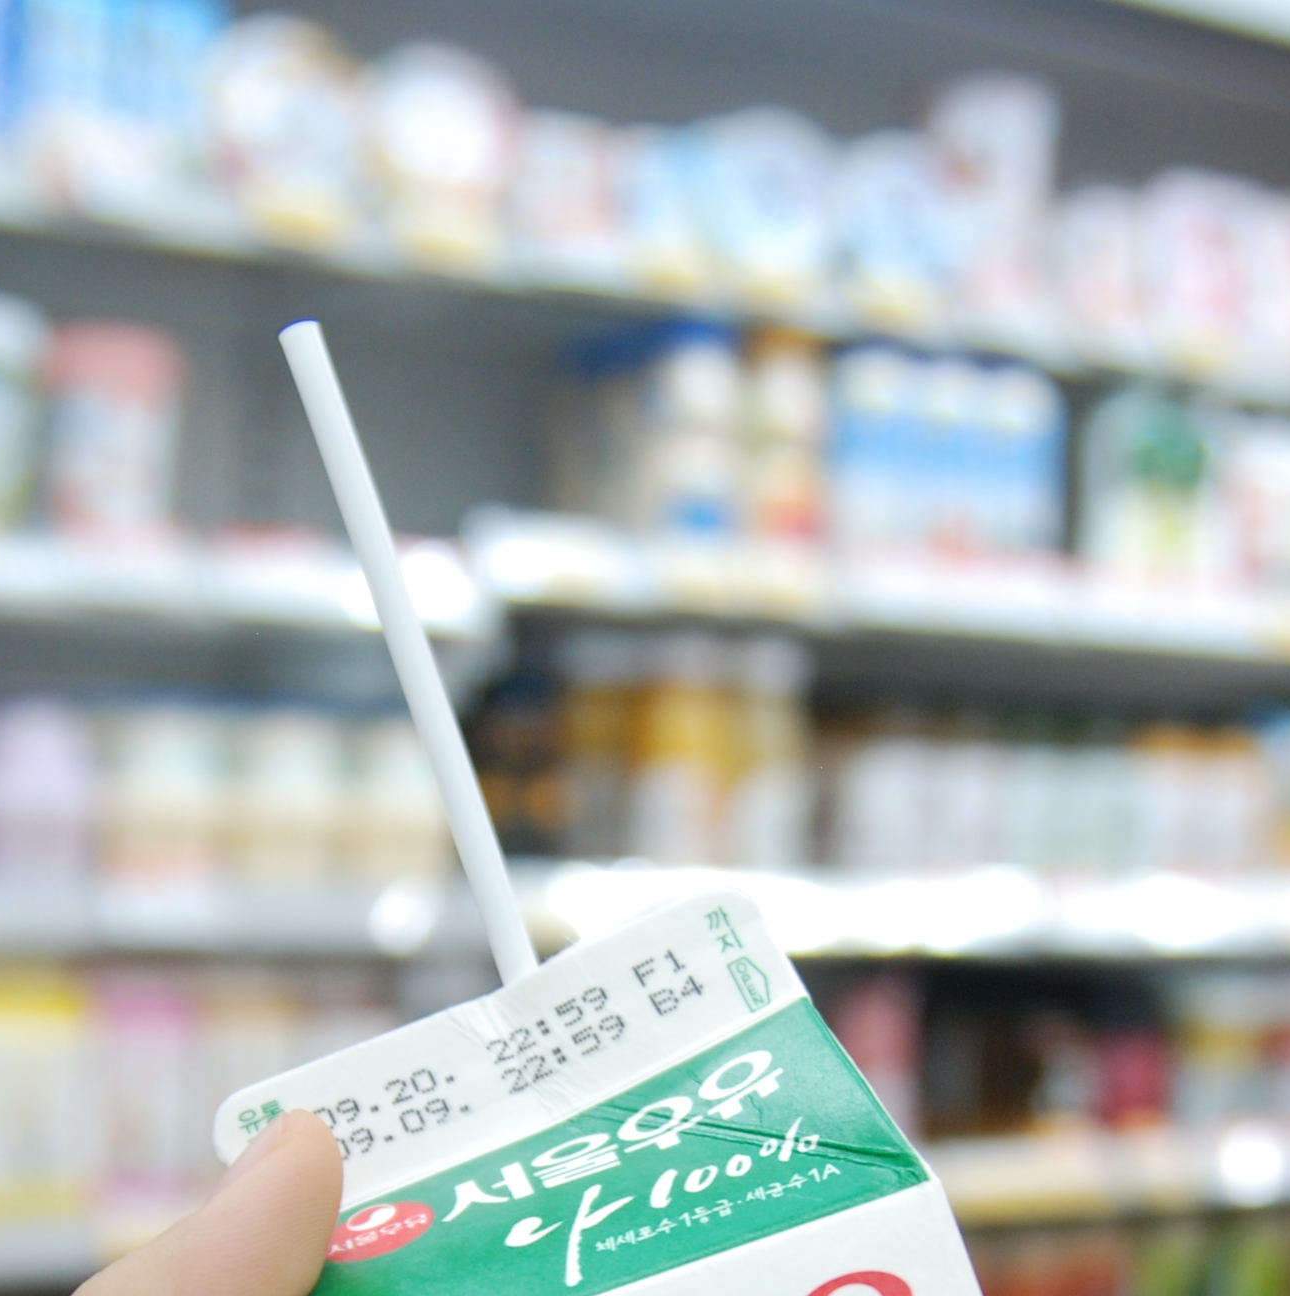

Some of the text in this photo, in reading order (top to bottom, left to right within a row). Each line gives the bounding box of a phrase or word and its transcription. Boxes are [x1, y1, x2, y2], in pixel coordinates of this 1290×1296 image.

[704, 905, 743, 953] 까지
[486, 985, 609, 1066] 22:59
[631, 948, 687, 989] F1
[500, 1013, 626, 1096] 22:59
[647, 974, 705, 1017] B4
[442, 1050, 783, 1222] 서울우유
[327, 1212, 429, 1256] 서울우유
[504, 1116, 821, 1287] 나 100%
